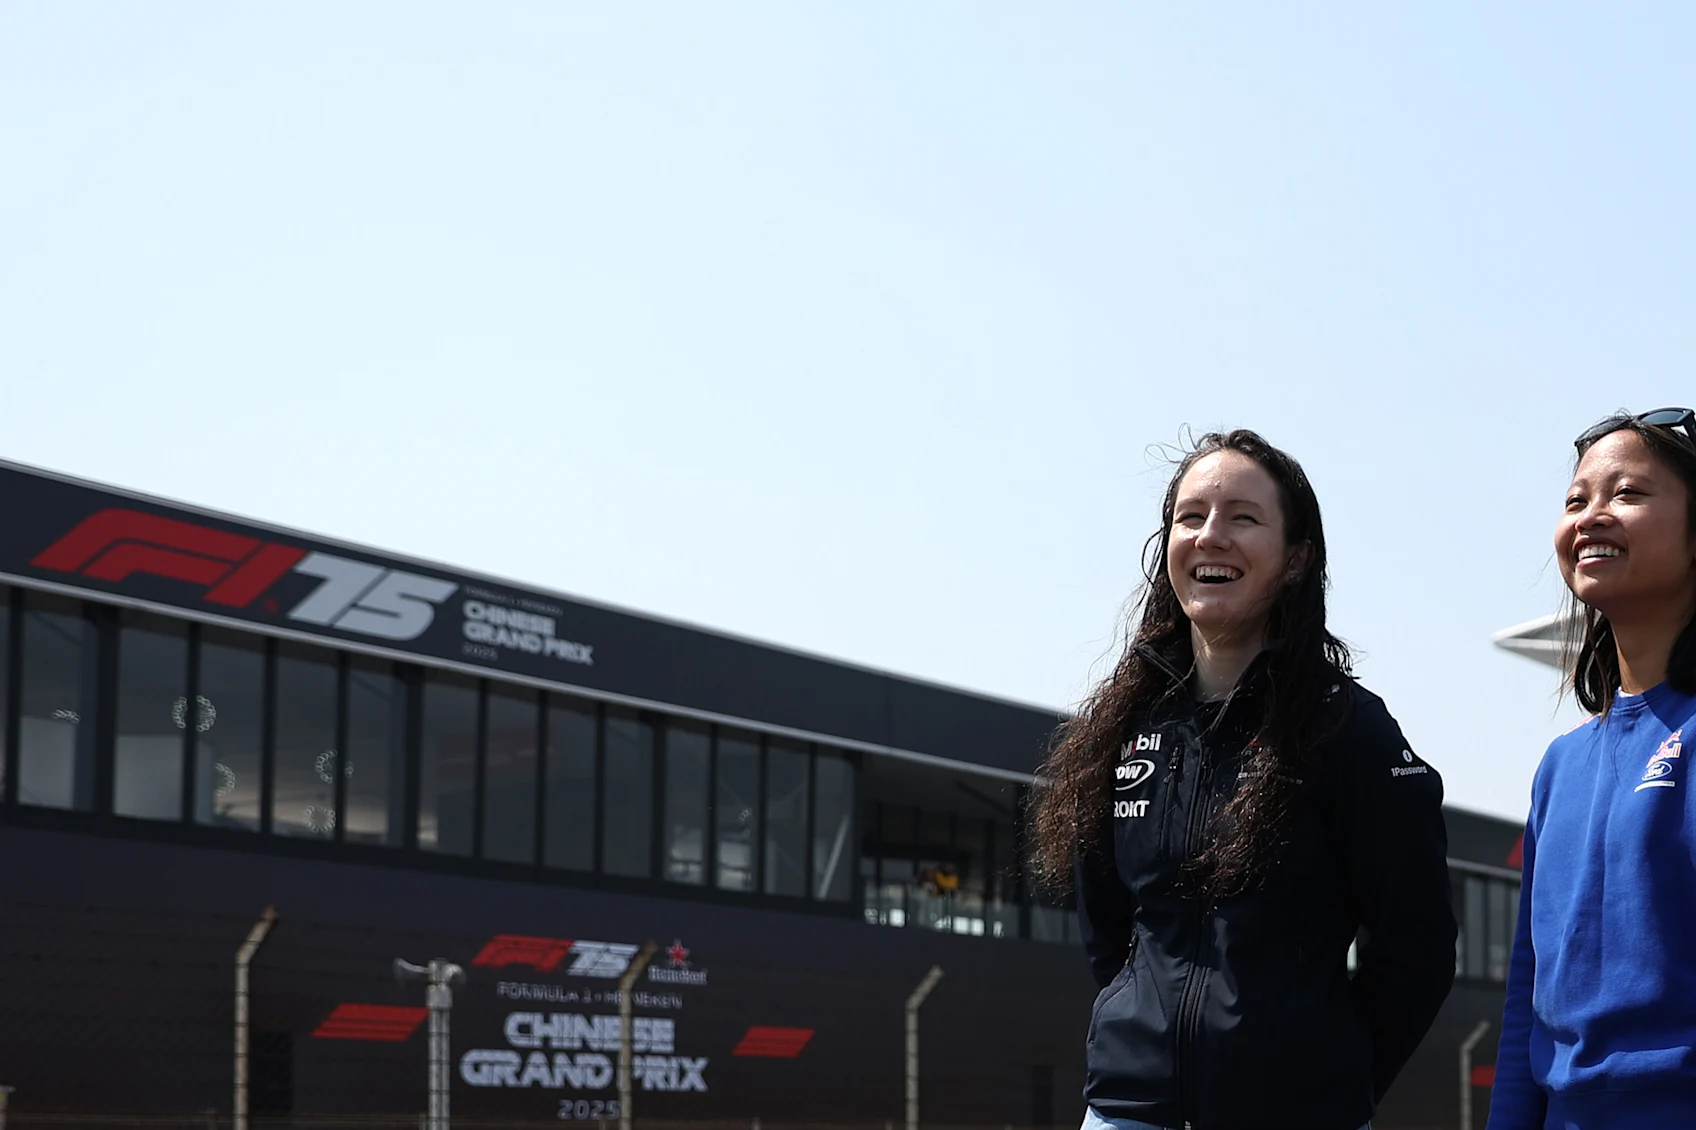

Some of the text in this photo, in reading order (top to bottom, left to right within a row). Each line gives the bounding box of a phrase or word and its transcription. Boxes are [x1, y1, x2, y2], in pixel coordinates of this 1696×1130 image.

[29, 508, 308, 608] F1
[462, 599, 556, 637] CHINESE
[461, 621, 595, 666] GRAND PRIX
[504, 1011, 675, 1053] CHINESE
[459, 1049, 614, 1090] GRAND
[557, 1099, 621, 1121] 2025
